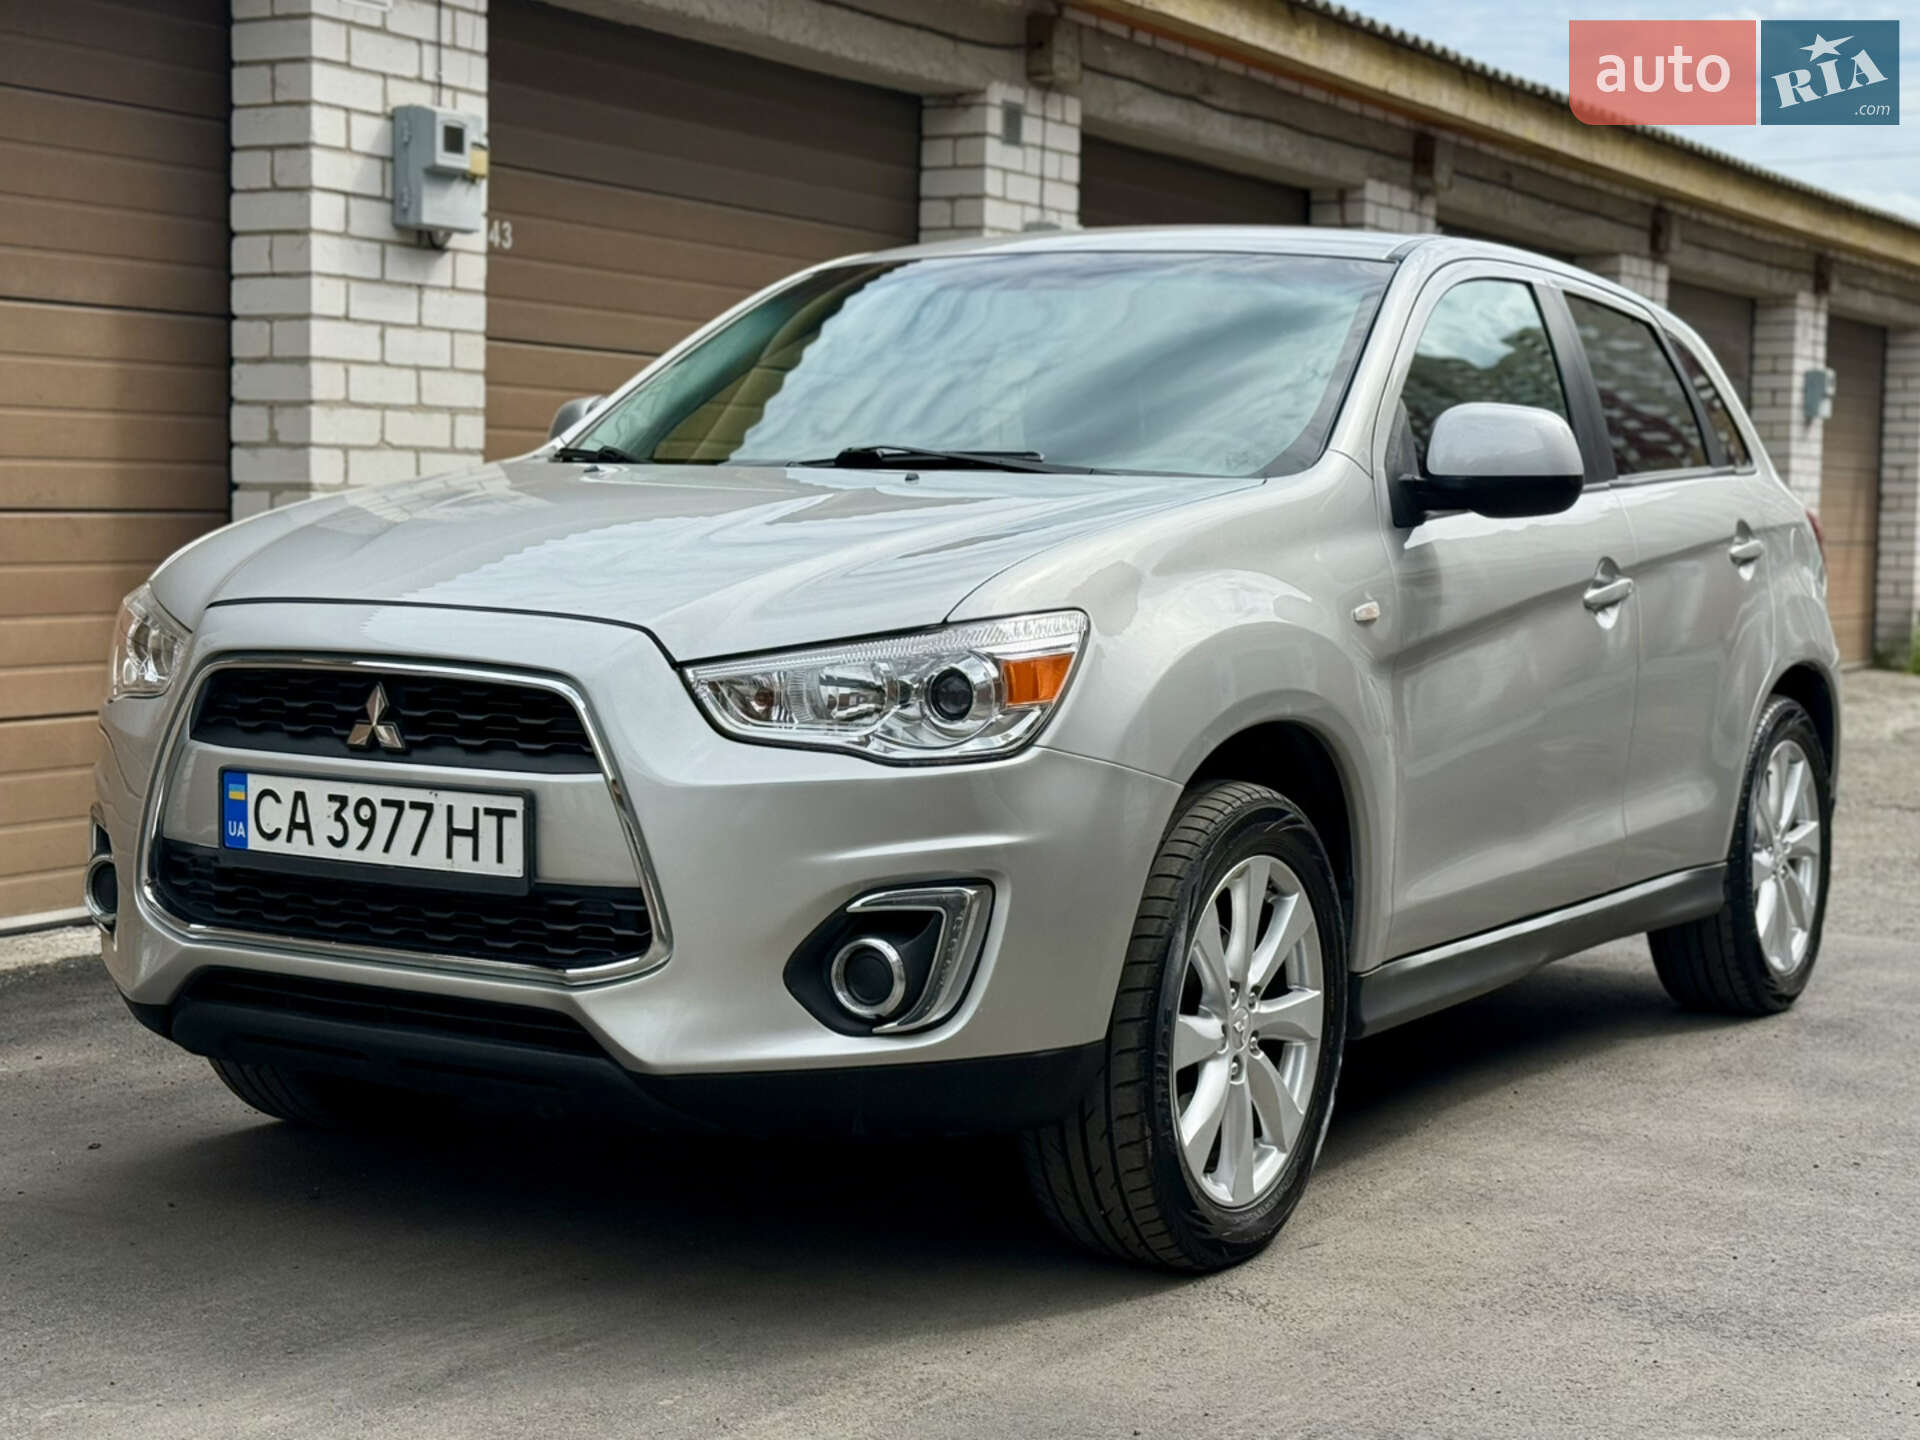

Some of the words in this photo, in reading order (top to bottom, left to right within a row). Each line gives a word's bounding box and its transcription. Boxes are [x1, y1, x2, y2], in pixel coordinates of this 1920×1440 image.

[489, 219, 513, 249] 43
[228, 820, 246, 838] UA
[254, 788, 314, 846] CA
[326, 793, 435, 856] 3977
[446, 802, 517, 863] HT
